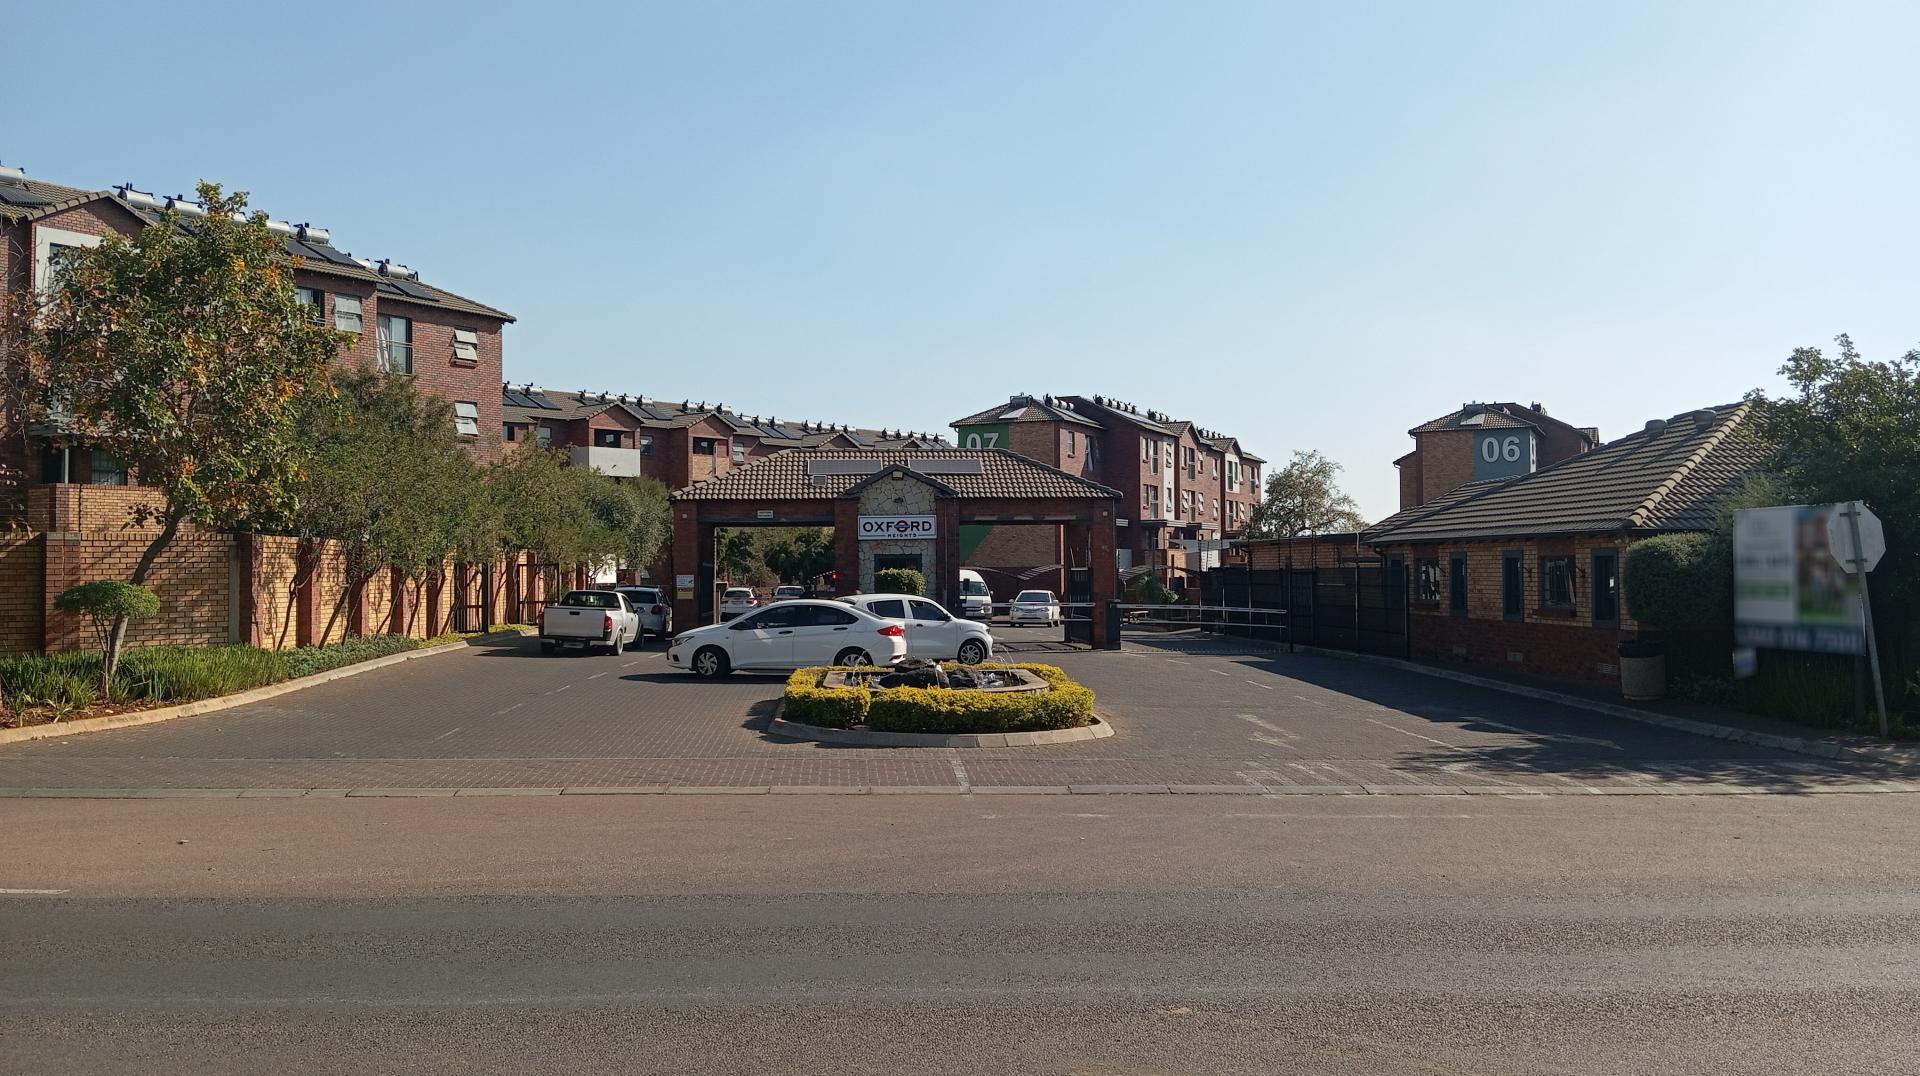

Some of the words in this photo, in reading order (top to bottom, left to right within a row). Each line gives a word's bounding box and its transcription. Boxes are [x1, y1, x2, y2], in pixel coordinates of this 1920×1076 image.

[966, 432, 999, 449] 07
[1481, 436, 1521, 463] 06
[863, 520, 932, 533] OXFORD
